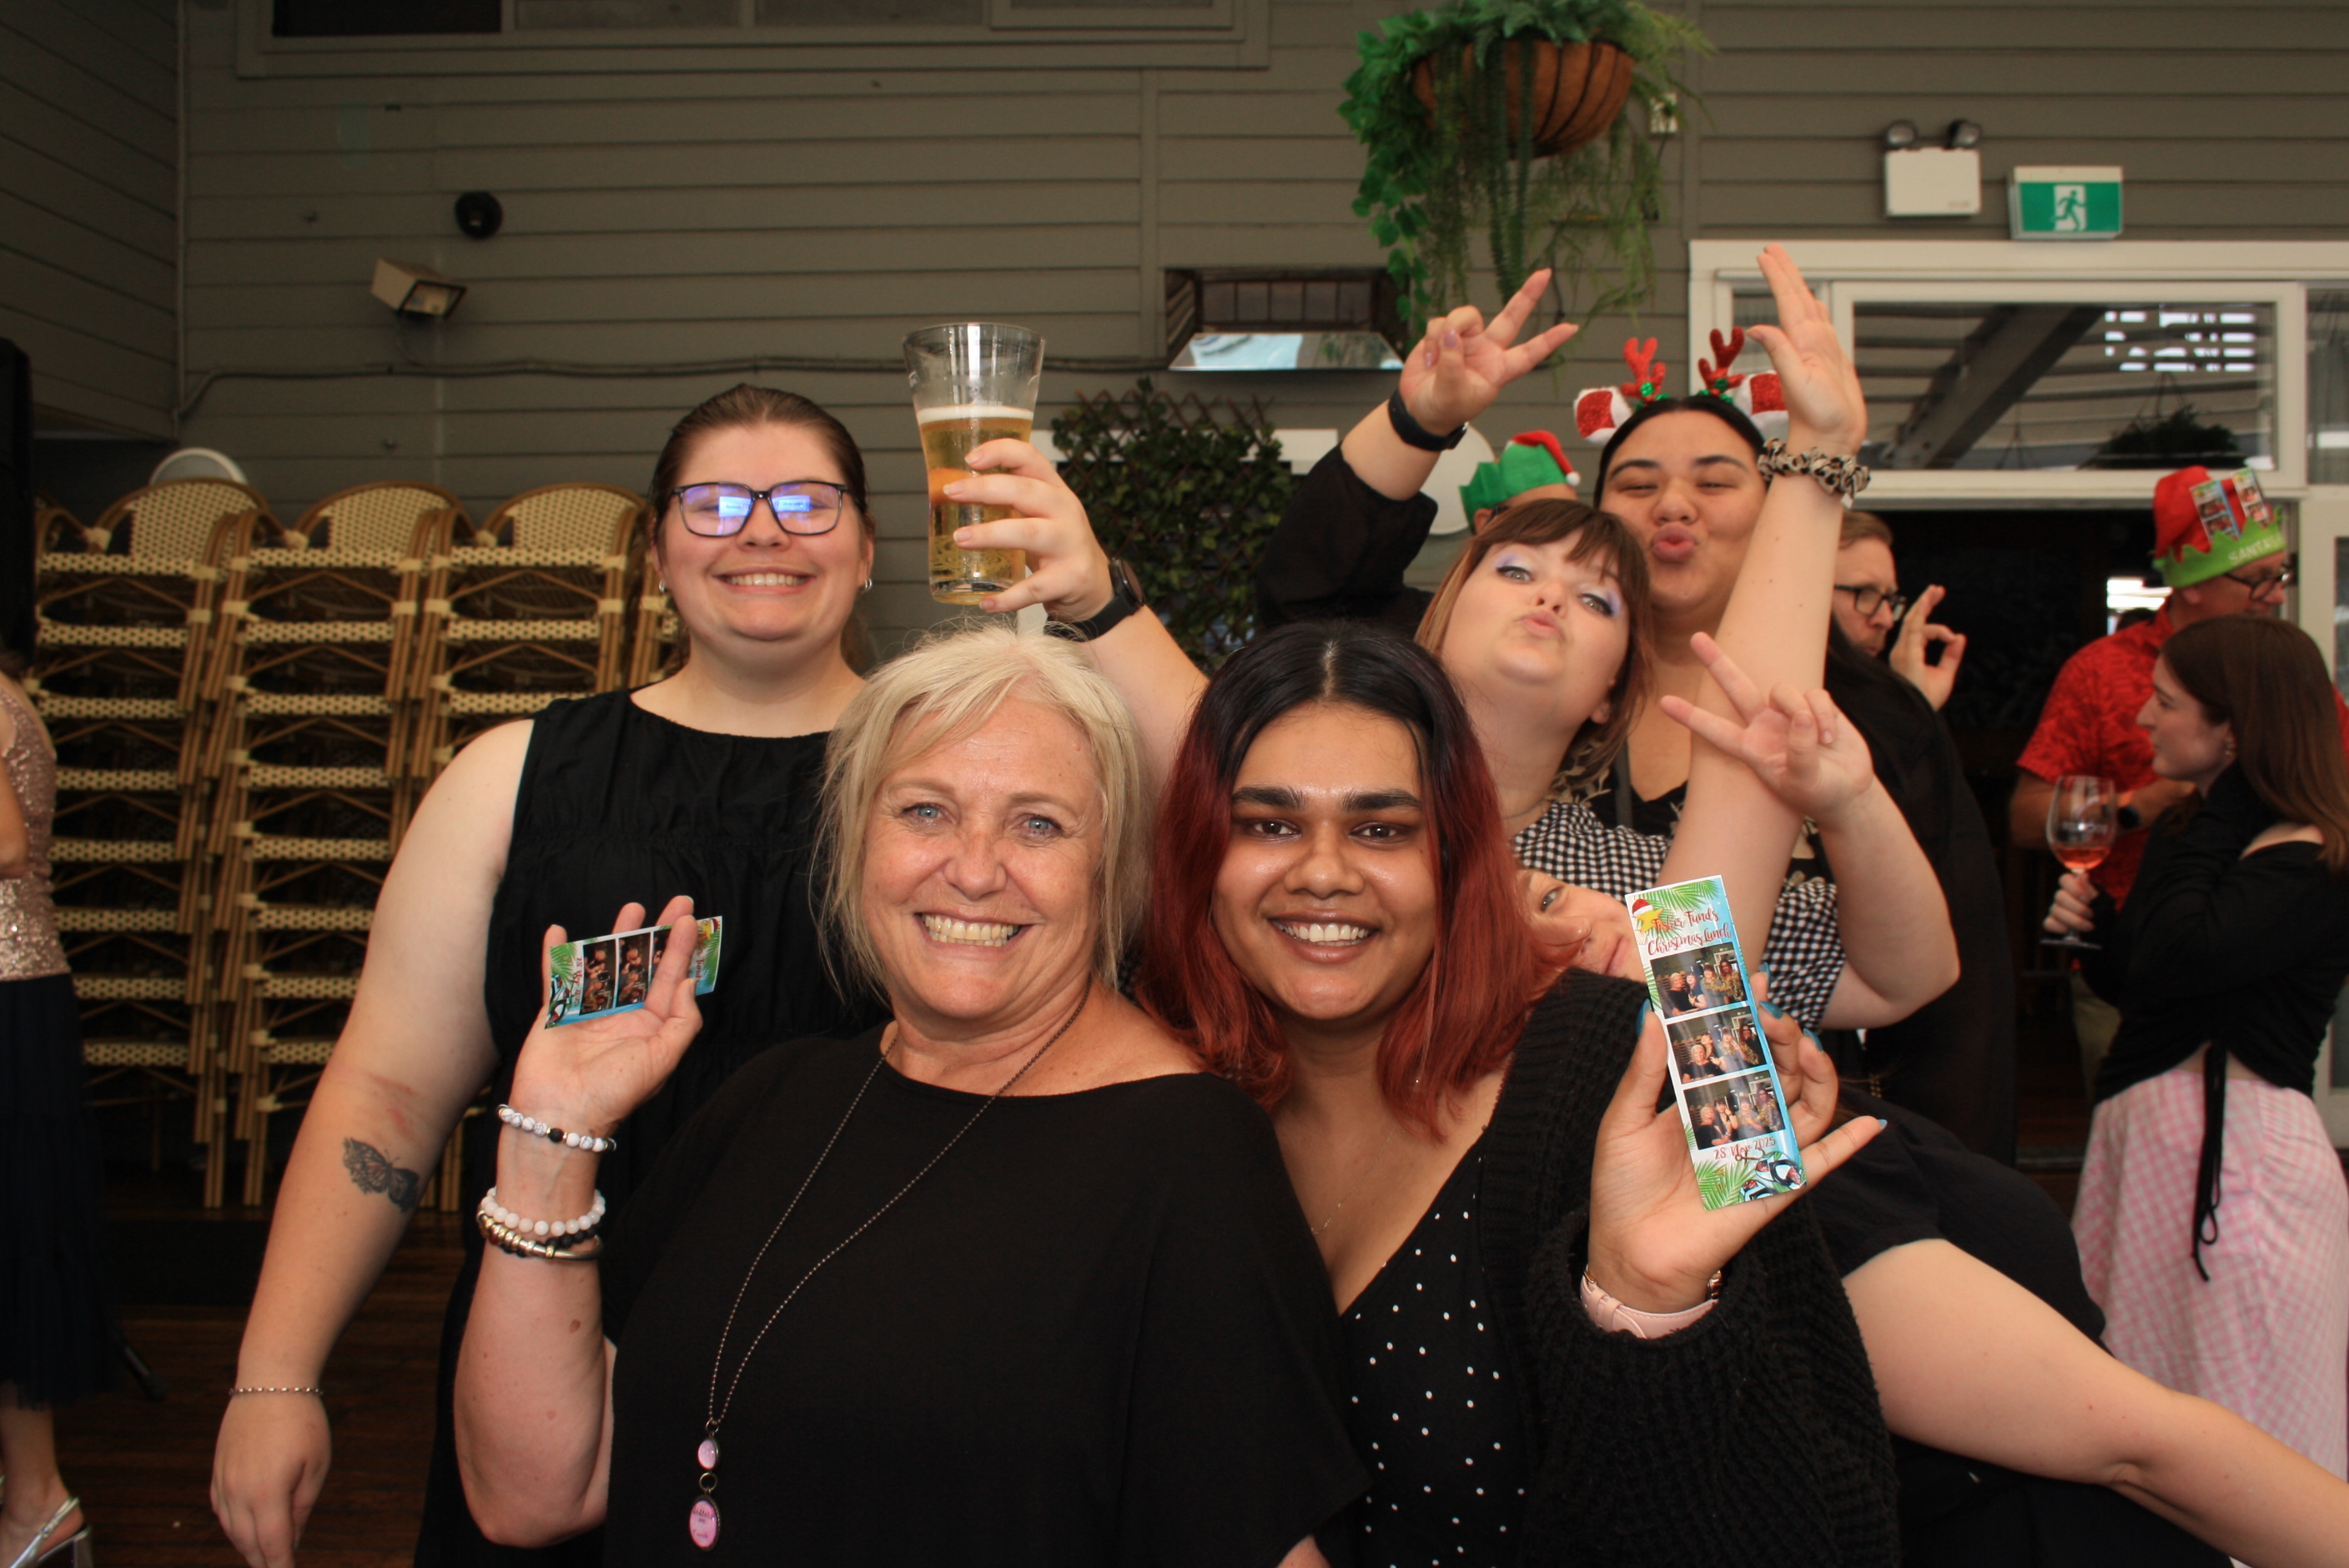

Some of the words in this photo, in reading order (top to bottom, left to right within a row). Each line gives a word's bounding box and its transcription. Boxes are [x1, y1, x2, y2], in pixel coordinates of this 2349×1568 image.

[1684, 907, 1719, 927] Funds
[1647, 935, 1703, 956] Christmas
[1703, 922, 1731, 942] Lunch
[1713, 1147, 1726, 1159] 28
[1753, 1137, 1776, 1150] 2025
